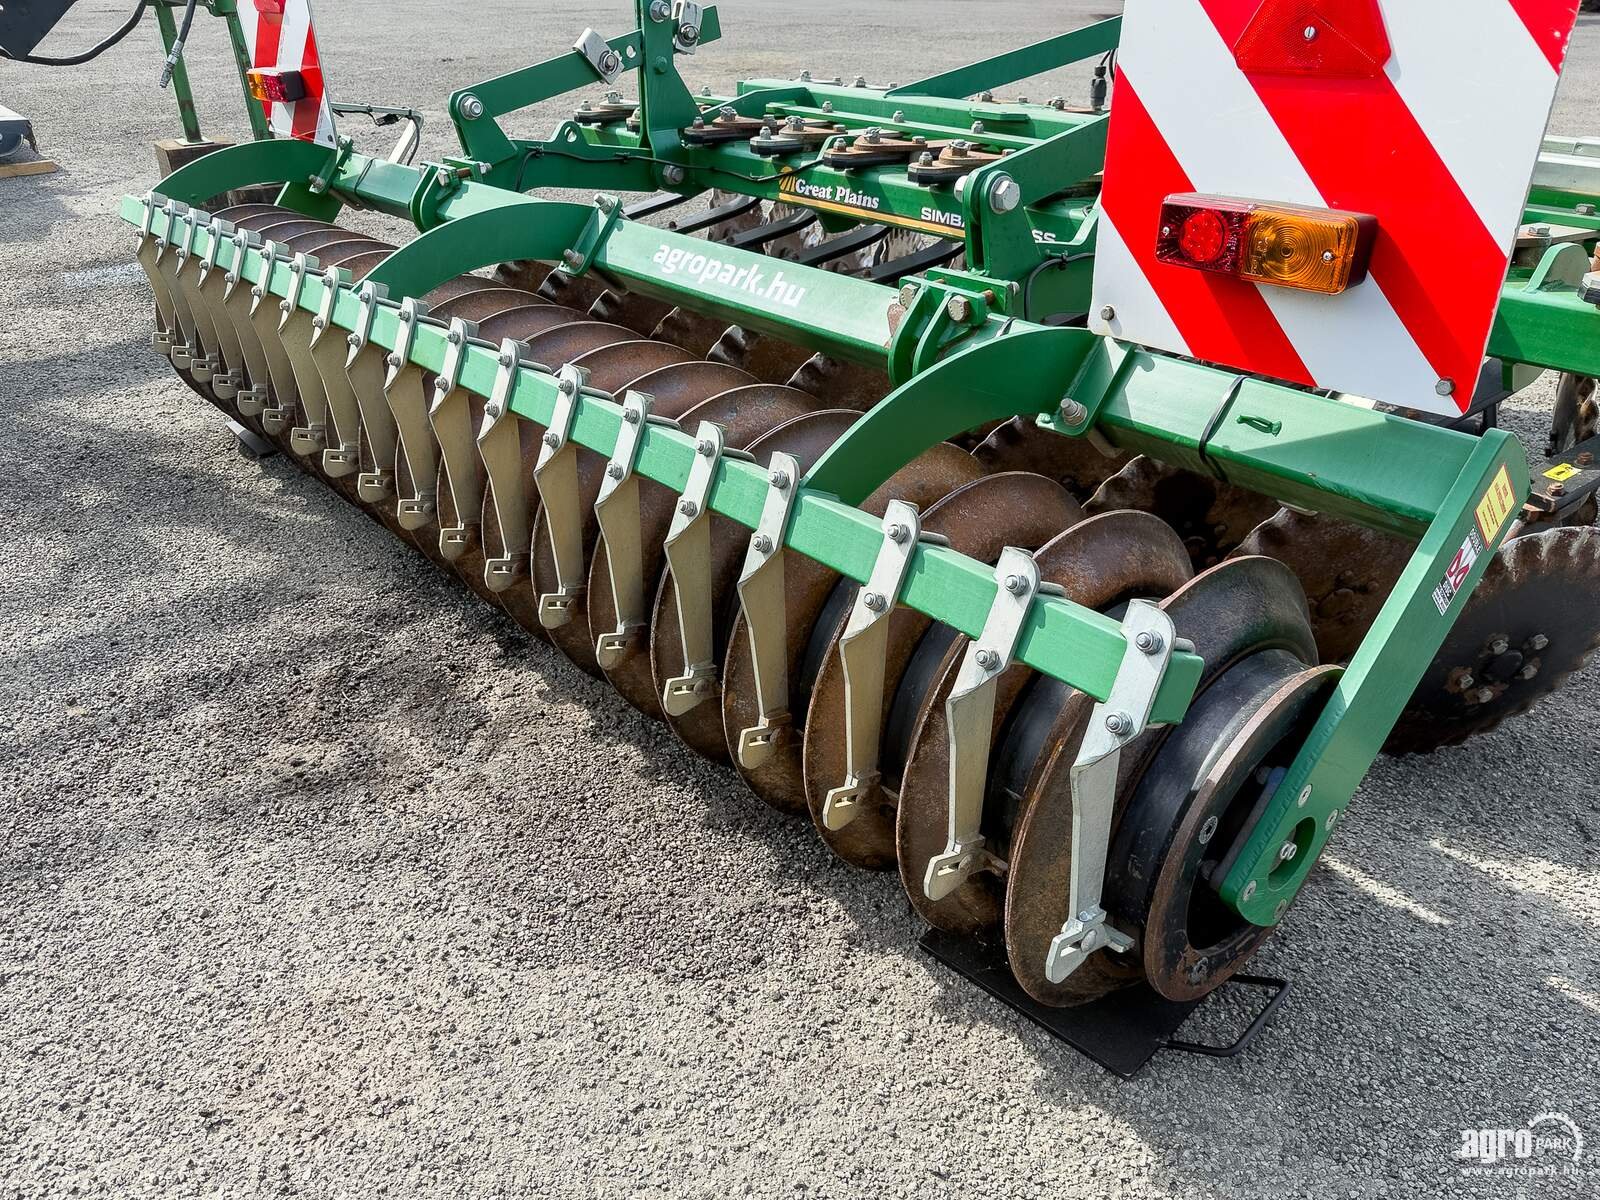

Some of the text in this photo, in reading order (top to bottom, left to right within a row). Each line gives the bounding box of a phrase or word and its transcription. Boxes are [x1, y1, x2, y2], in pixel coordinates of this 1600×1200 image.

[795, 179, 880, 209] Great Plains
[920, 207, 965, 228] SIMB
[652, 244, 806, 308] agropark.hu
